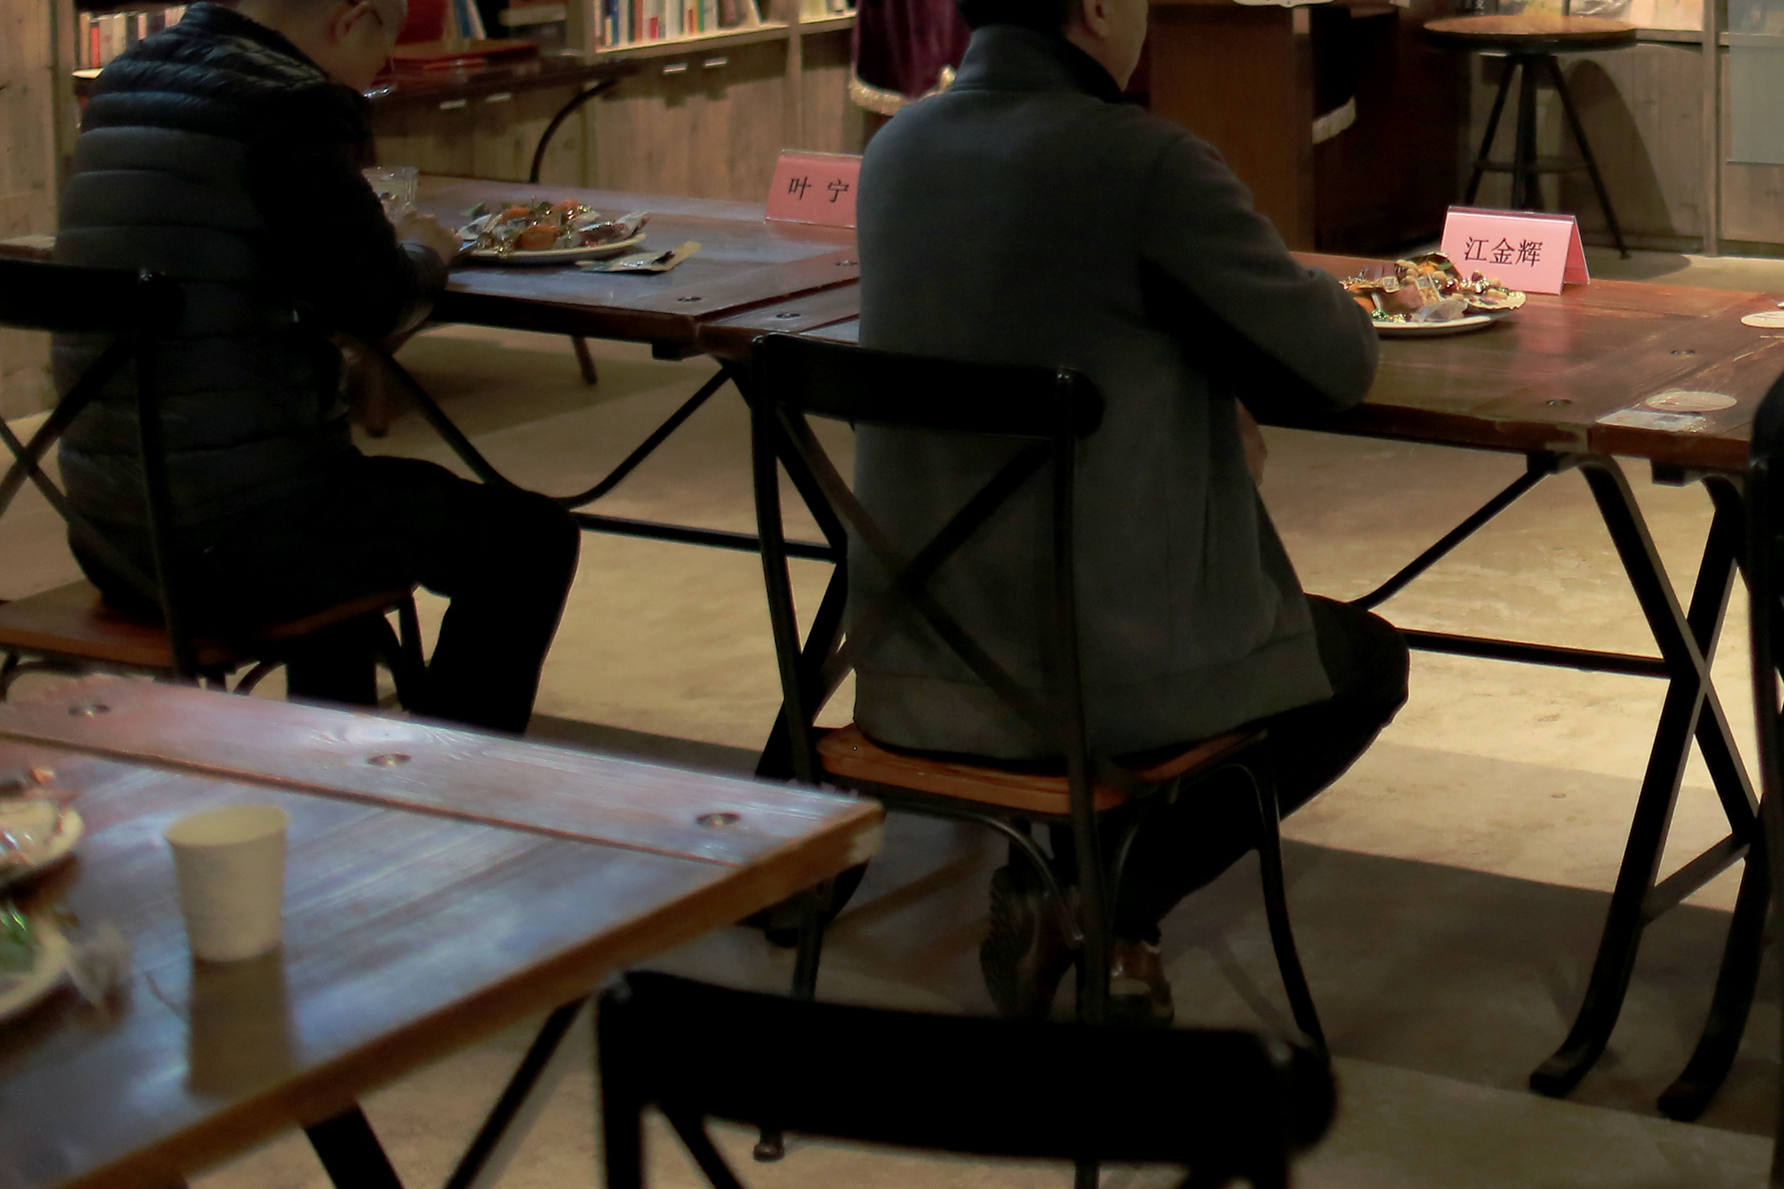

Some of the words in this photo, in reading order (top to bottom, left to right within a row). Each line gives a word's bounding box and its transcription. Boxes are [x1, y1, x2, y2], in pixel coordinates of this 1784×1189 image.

[788, 176, 850, 203] 叶宁
[1463, 236, 1544, 268] 江金辉
